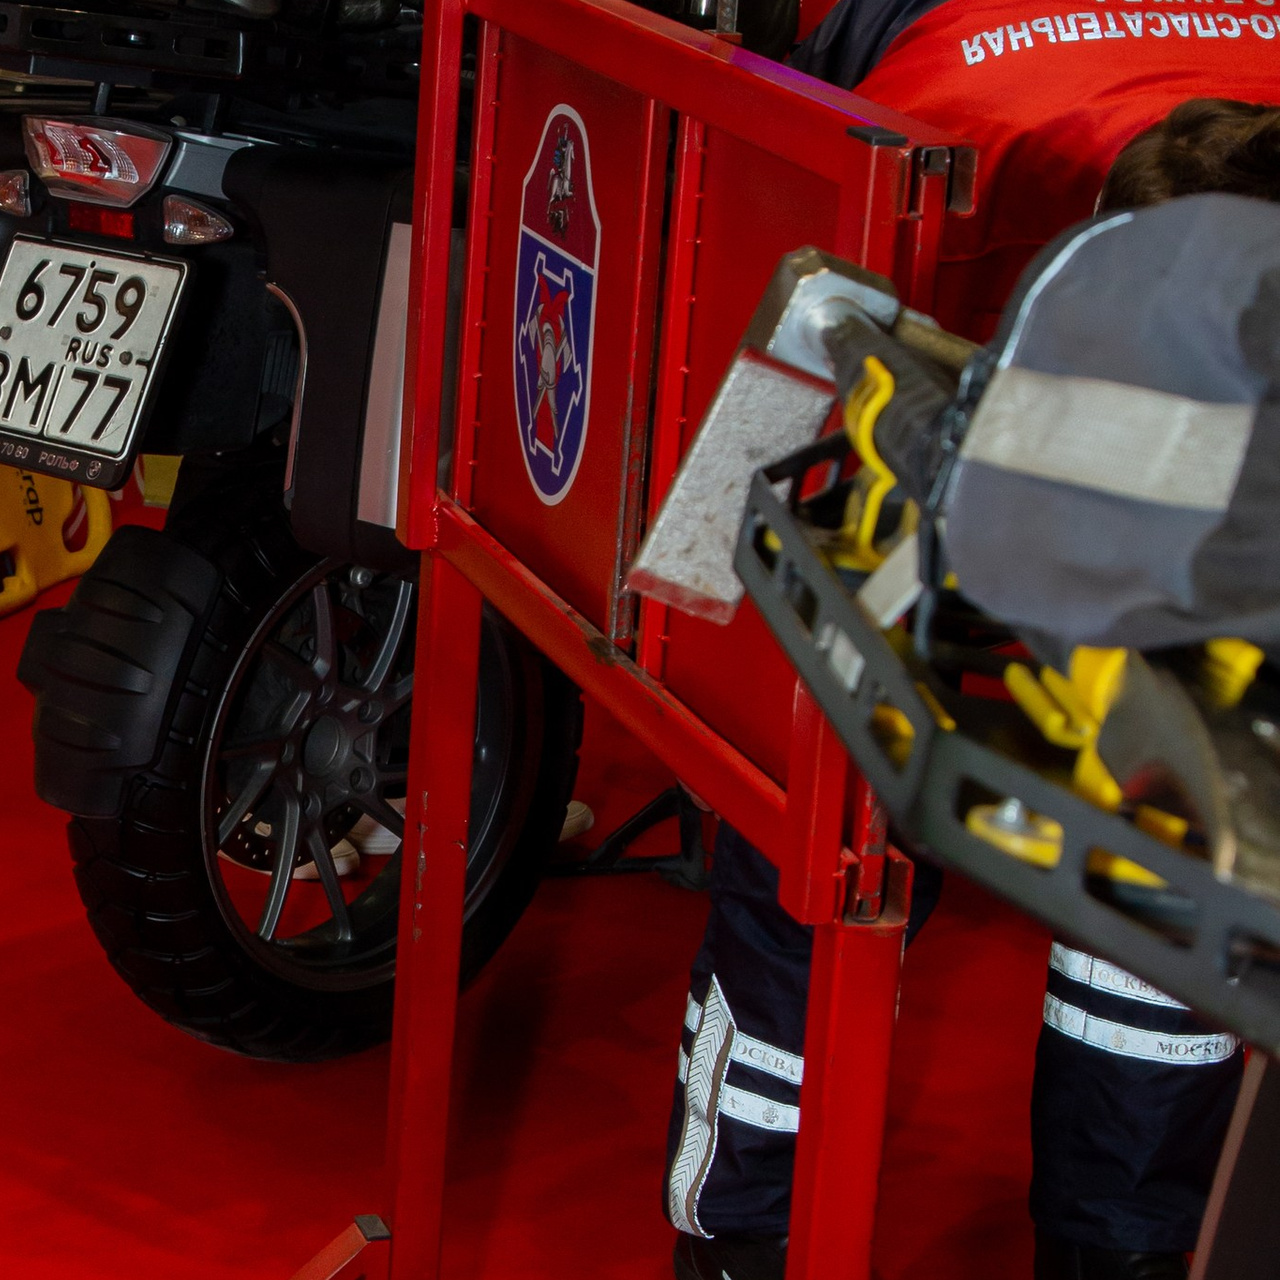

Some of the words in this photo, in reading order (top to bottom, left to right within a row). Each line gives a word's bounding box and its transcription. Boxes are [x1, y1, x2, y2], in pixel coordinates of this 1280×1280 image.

[961, 10, 1280, 65] О-СПАСАТЕЛЬНАЯ
[15, 259, 147, 341] 6759
[66, 336, 114, 368] RUS
[59, 367, 133, 442] 77
[38, 450, 80, 472] РОЛЬФ
